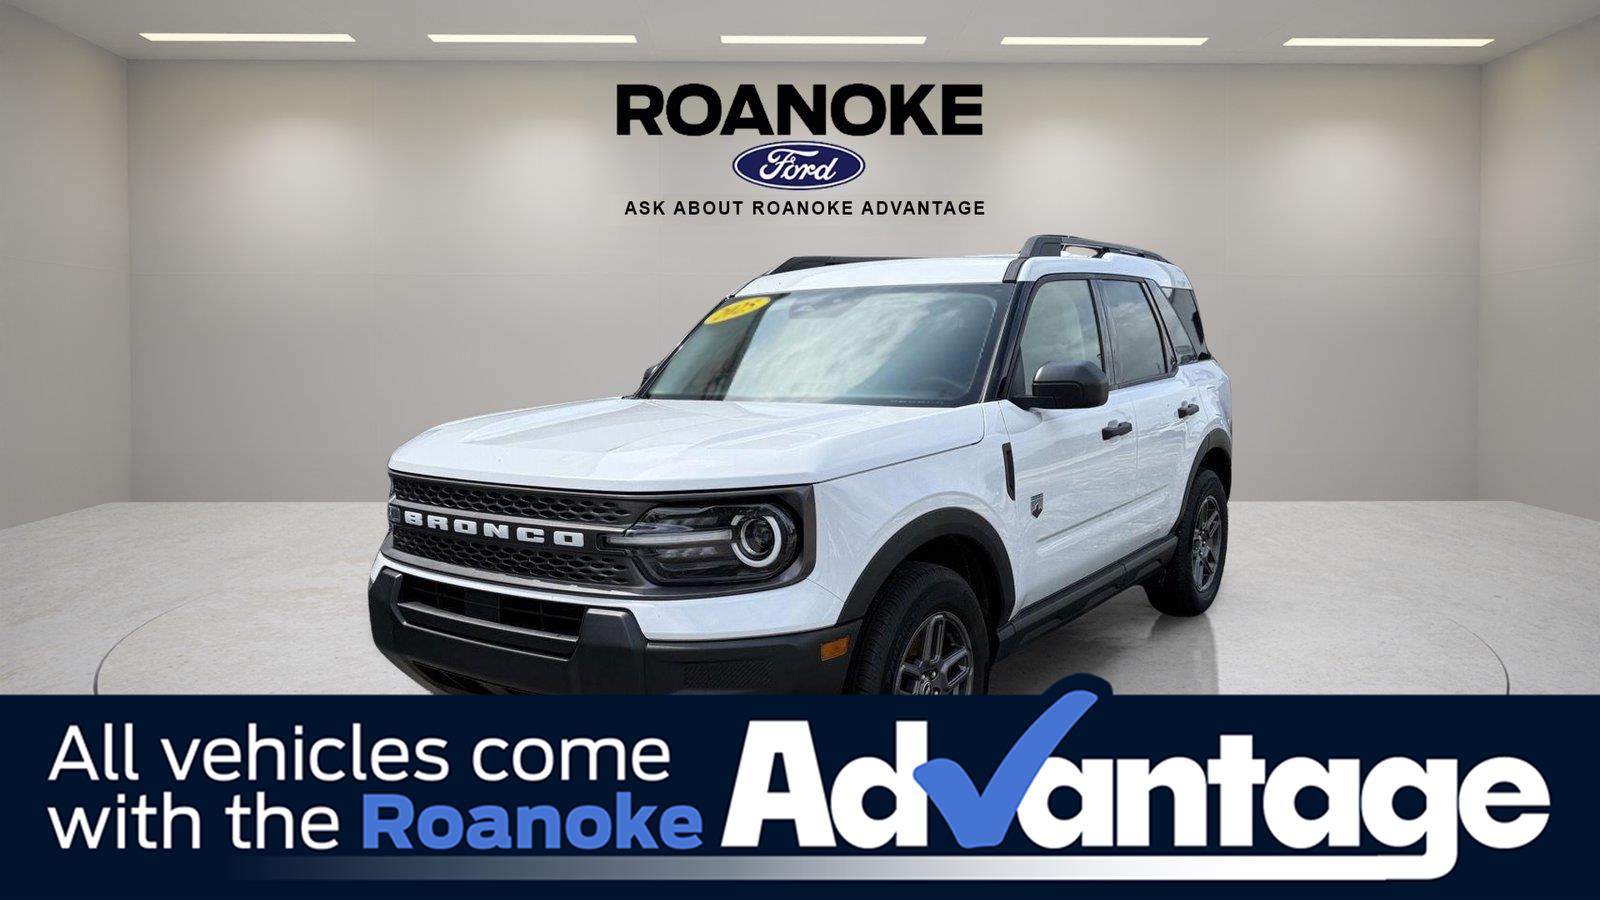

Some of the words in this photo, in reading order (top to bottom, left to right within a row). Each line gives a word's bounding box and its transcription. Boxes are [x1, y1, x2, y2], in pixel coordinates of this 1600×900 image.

[616, 83, 983, 136] ROANOKE
[758, 148, 839, 181] Ford
[624, 200, 666, 215] ASK
[674, 200, 744, 215] ABOUT
[752, 200, 853, 215] ROANOKE
[861, 200, 985, 215] ADVANTAGE
[404, 510, 585, 548] BRONCO
